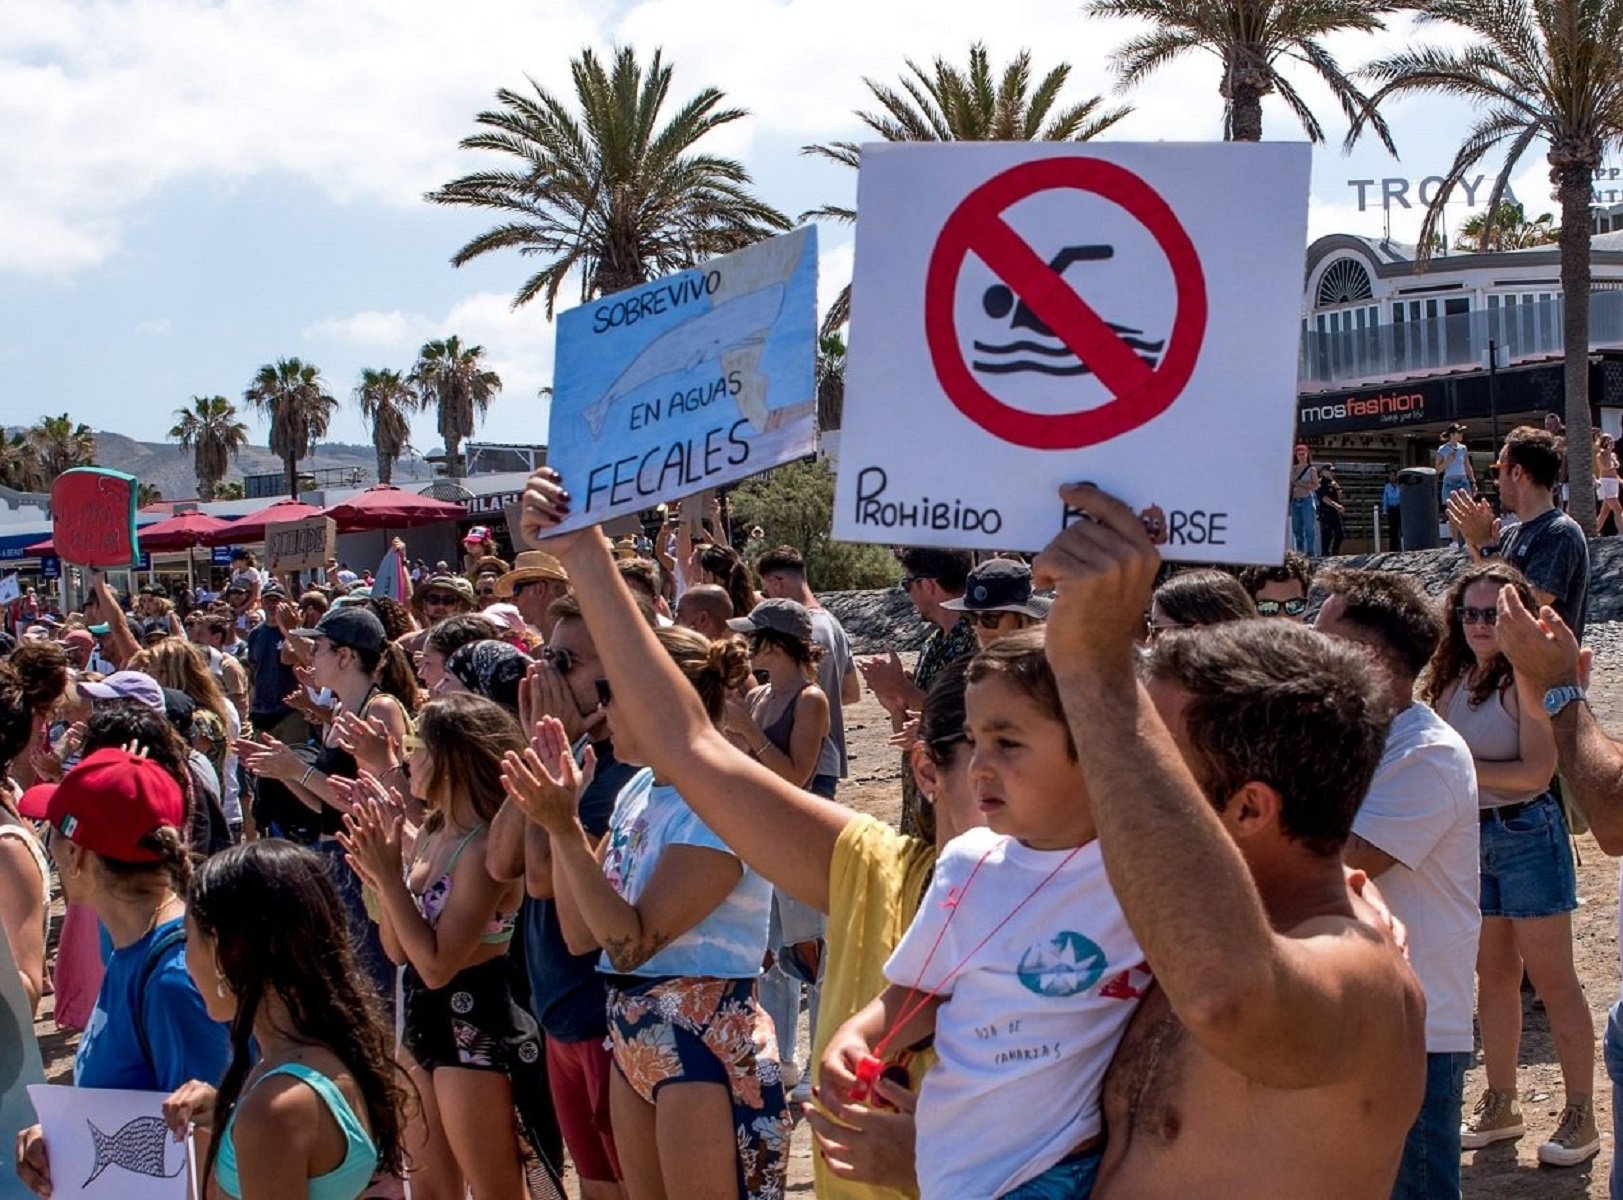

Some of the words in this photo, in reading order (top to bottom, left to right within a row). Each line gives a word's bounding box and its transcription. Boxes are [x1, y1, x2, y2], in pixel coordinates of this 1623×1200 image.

[630, 398, 660, 430] EN
[668, 371, 743, 418] AGUAS
[1301, 392, 1424, 422] mosfashion
[585, 418, 750, 513] FECALES
